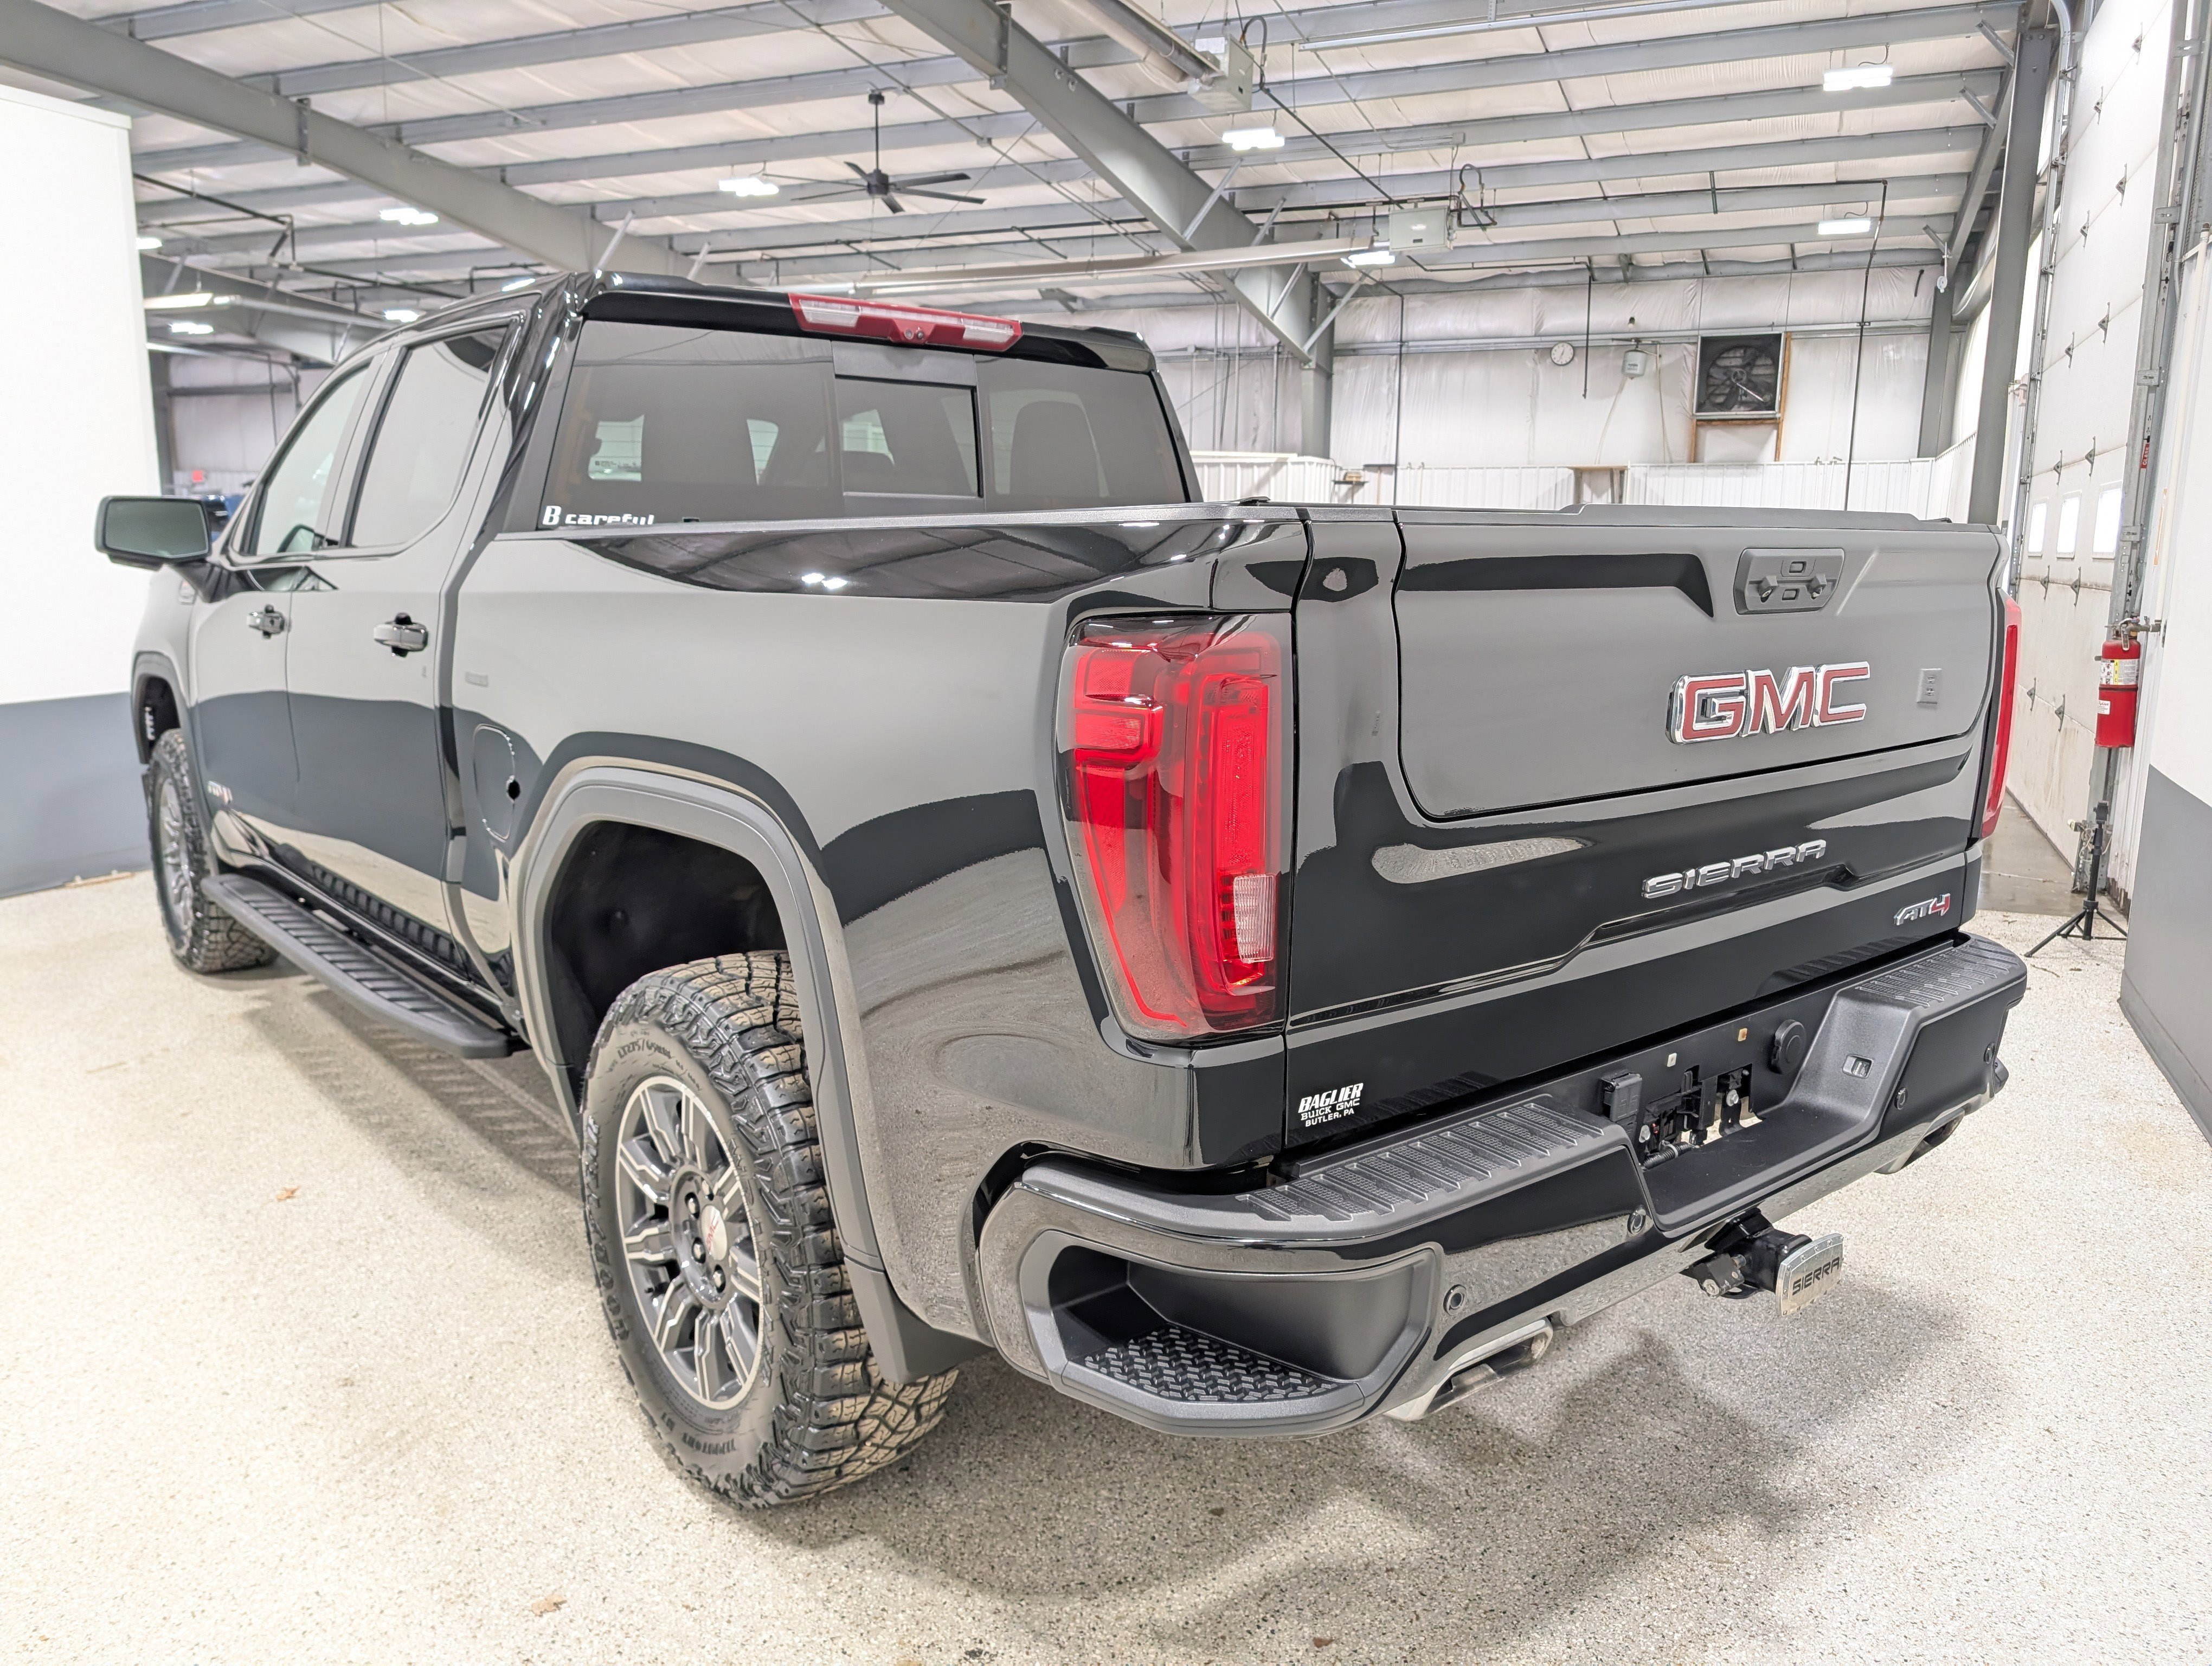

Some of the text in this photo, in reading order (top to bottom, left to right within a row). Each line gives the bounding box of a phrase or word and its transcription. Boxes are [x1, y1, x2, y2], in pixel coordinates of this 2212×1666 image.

[542, 505, 655, 526] B careful
[1666, 661, 1870, 745] GMC
[1641, 838, 1827, 899] SIERRA
[1894, 893, 1951, 926] AT4
[1298, 1082, 1364, 1113] BAGLIER
[1300, 1098, 1360, 1121] BUICK GMC
[1305, 1107, 1355, 1127] BUTLER, PA
[1792, 1256, 1840, 1296] SIERRA
